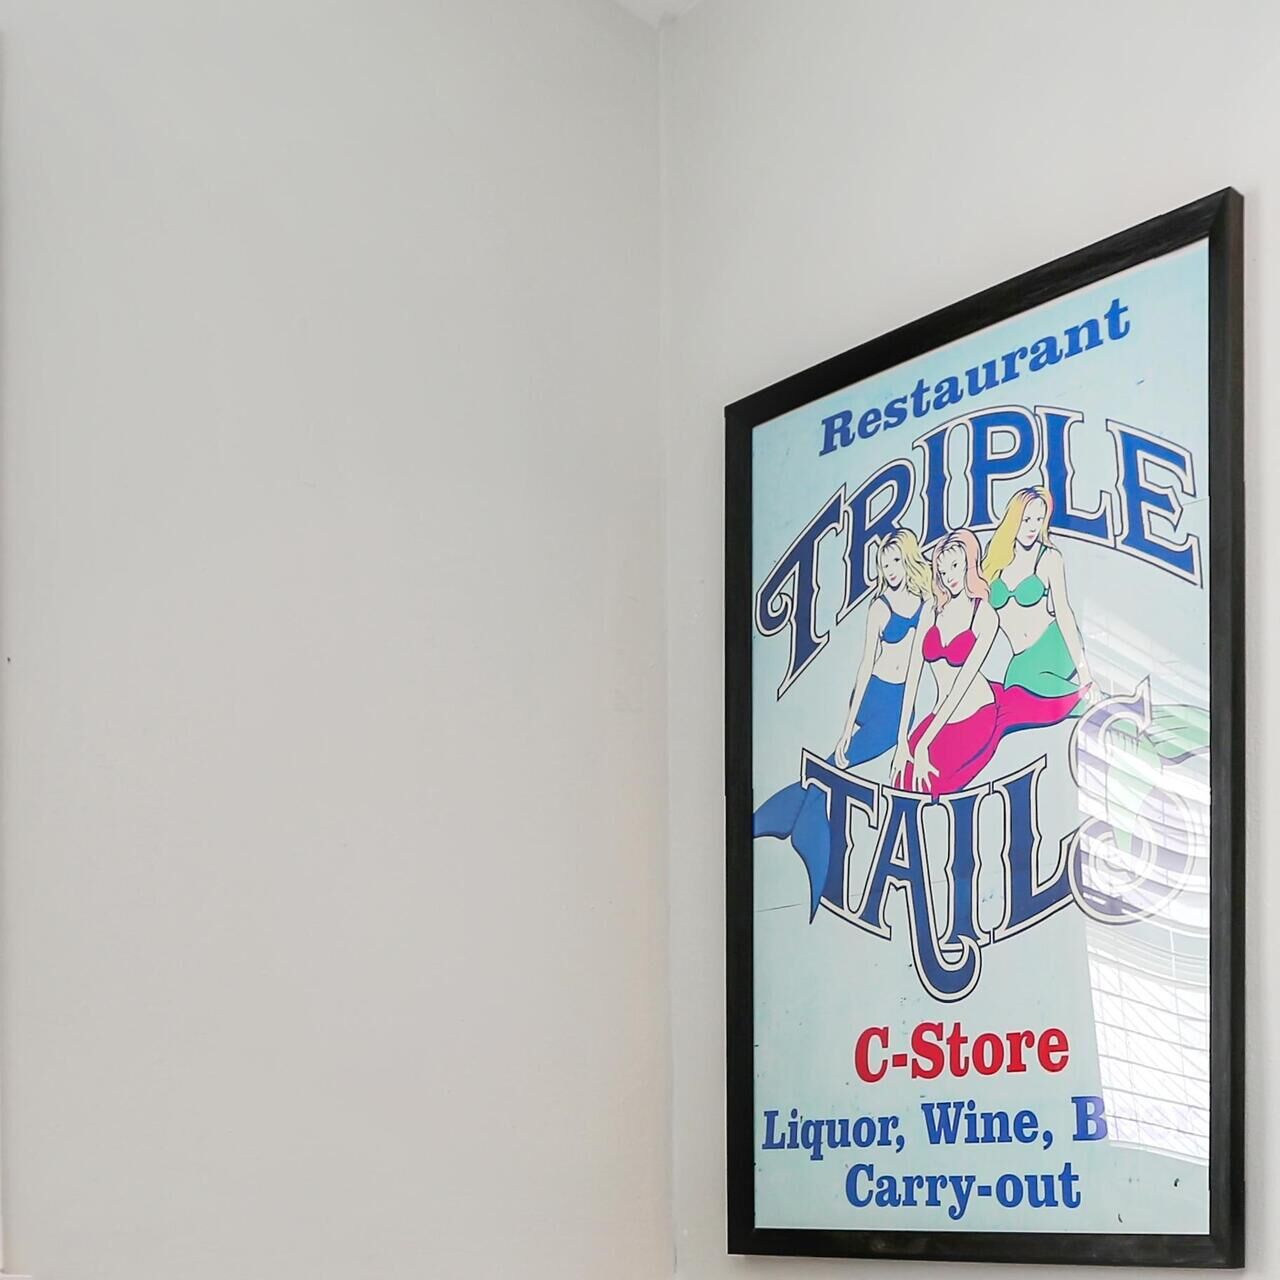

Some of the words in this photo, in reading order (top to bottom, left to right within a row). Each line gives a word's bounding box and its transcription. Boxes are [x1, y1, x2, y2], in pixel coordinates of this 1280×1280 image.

[819, 298, 1131, 456] Restaurant
[755, 404, 1204, 702] TRIPLE
[800, 674, 1197, 1004] TAILS
[854, 1021, 1070, 1083] C-Store
[761, 1108, 906, 1162] Liquor,
[921, 1099, 1054, 1150] Wine,
[845, 1161, 1082, 1221] Carry-out
